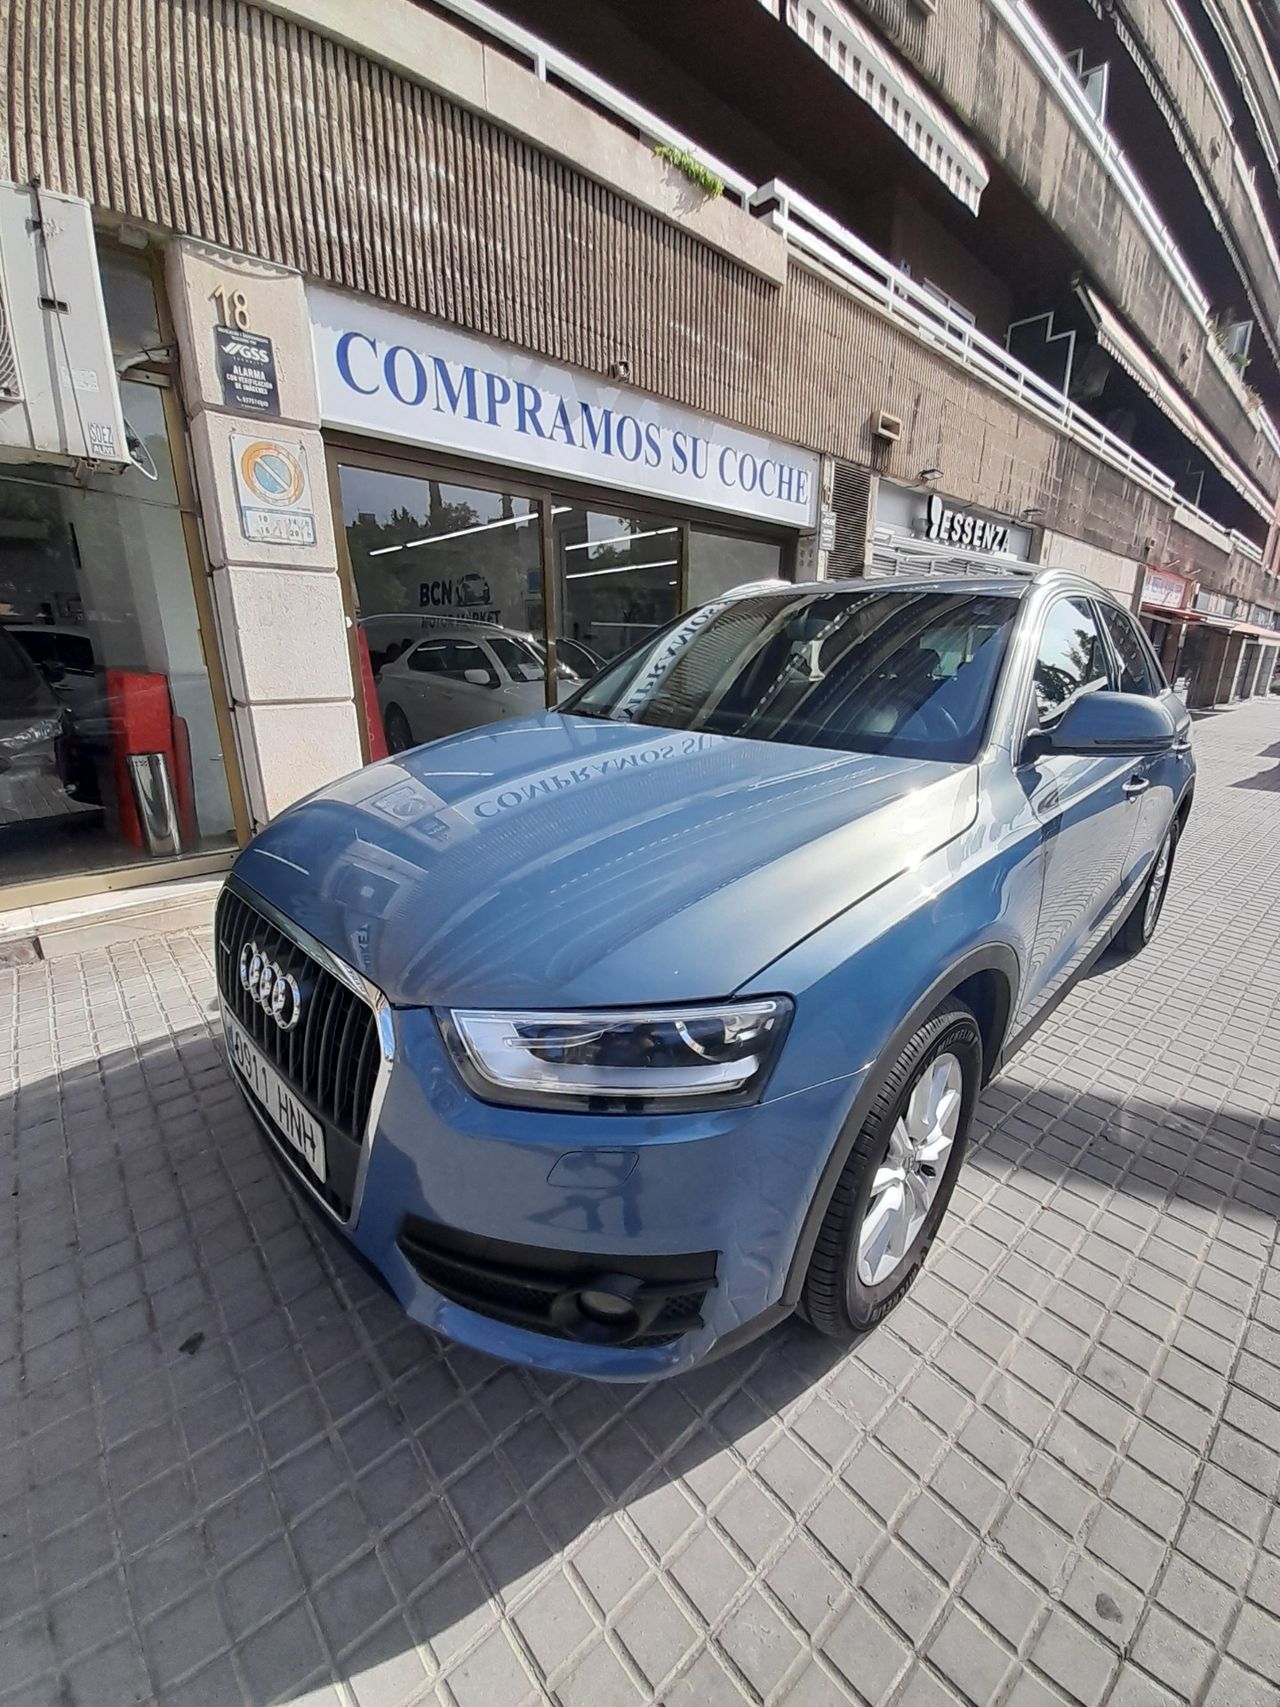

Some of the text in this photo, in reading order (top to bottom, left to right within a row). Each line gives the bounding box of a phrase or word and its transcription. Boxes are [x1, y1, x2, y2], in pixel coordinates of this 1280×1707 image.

[214, 285, 250, 330] 18
[233, 364, 266, 381] ALARMA
[239, 345, 270, 363] GSS
[336, 331, 810, 505] COMPRAMOS SU COCHE
[939, 509, 1011, 553] ESSENZA
[419, 580, 452, 607] BCN
[276, 1083, 317, 1164] HNH
